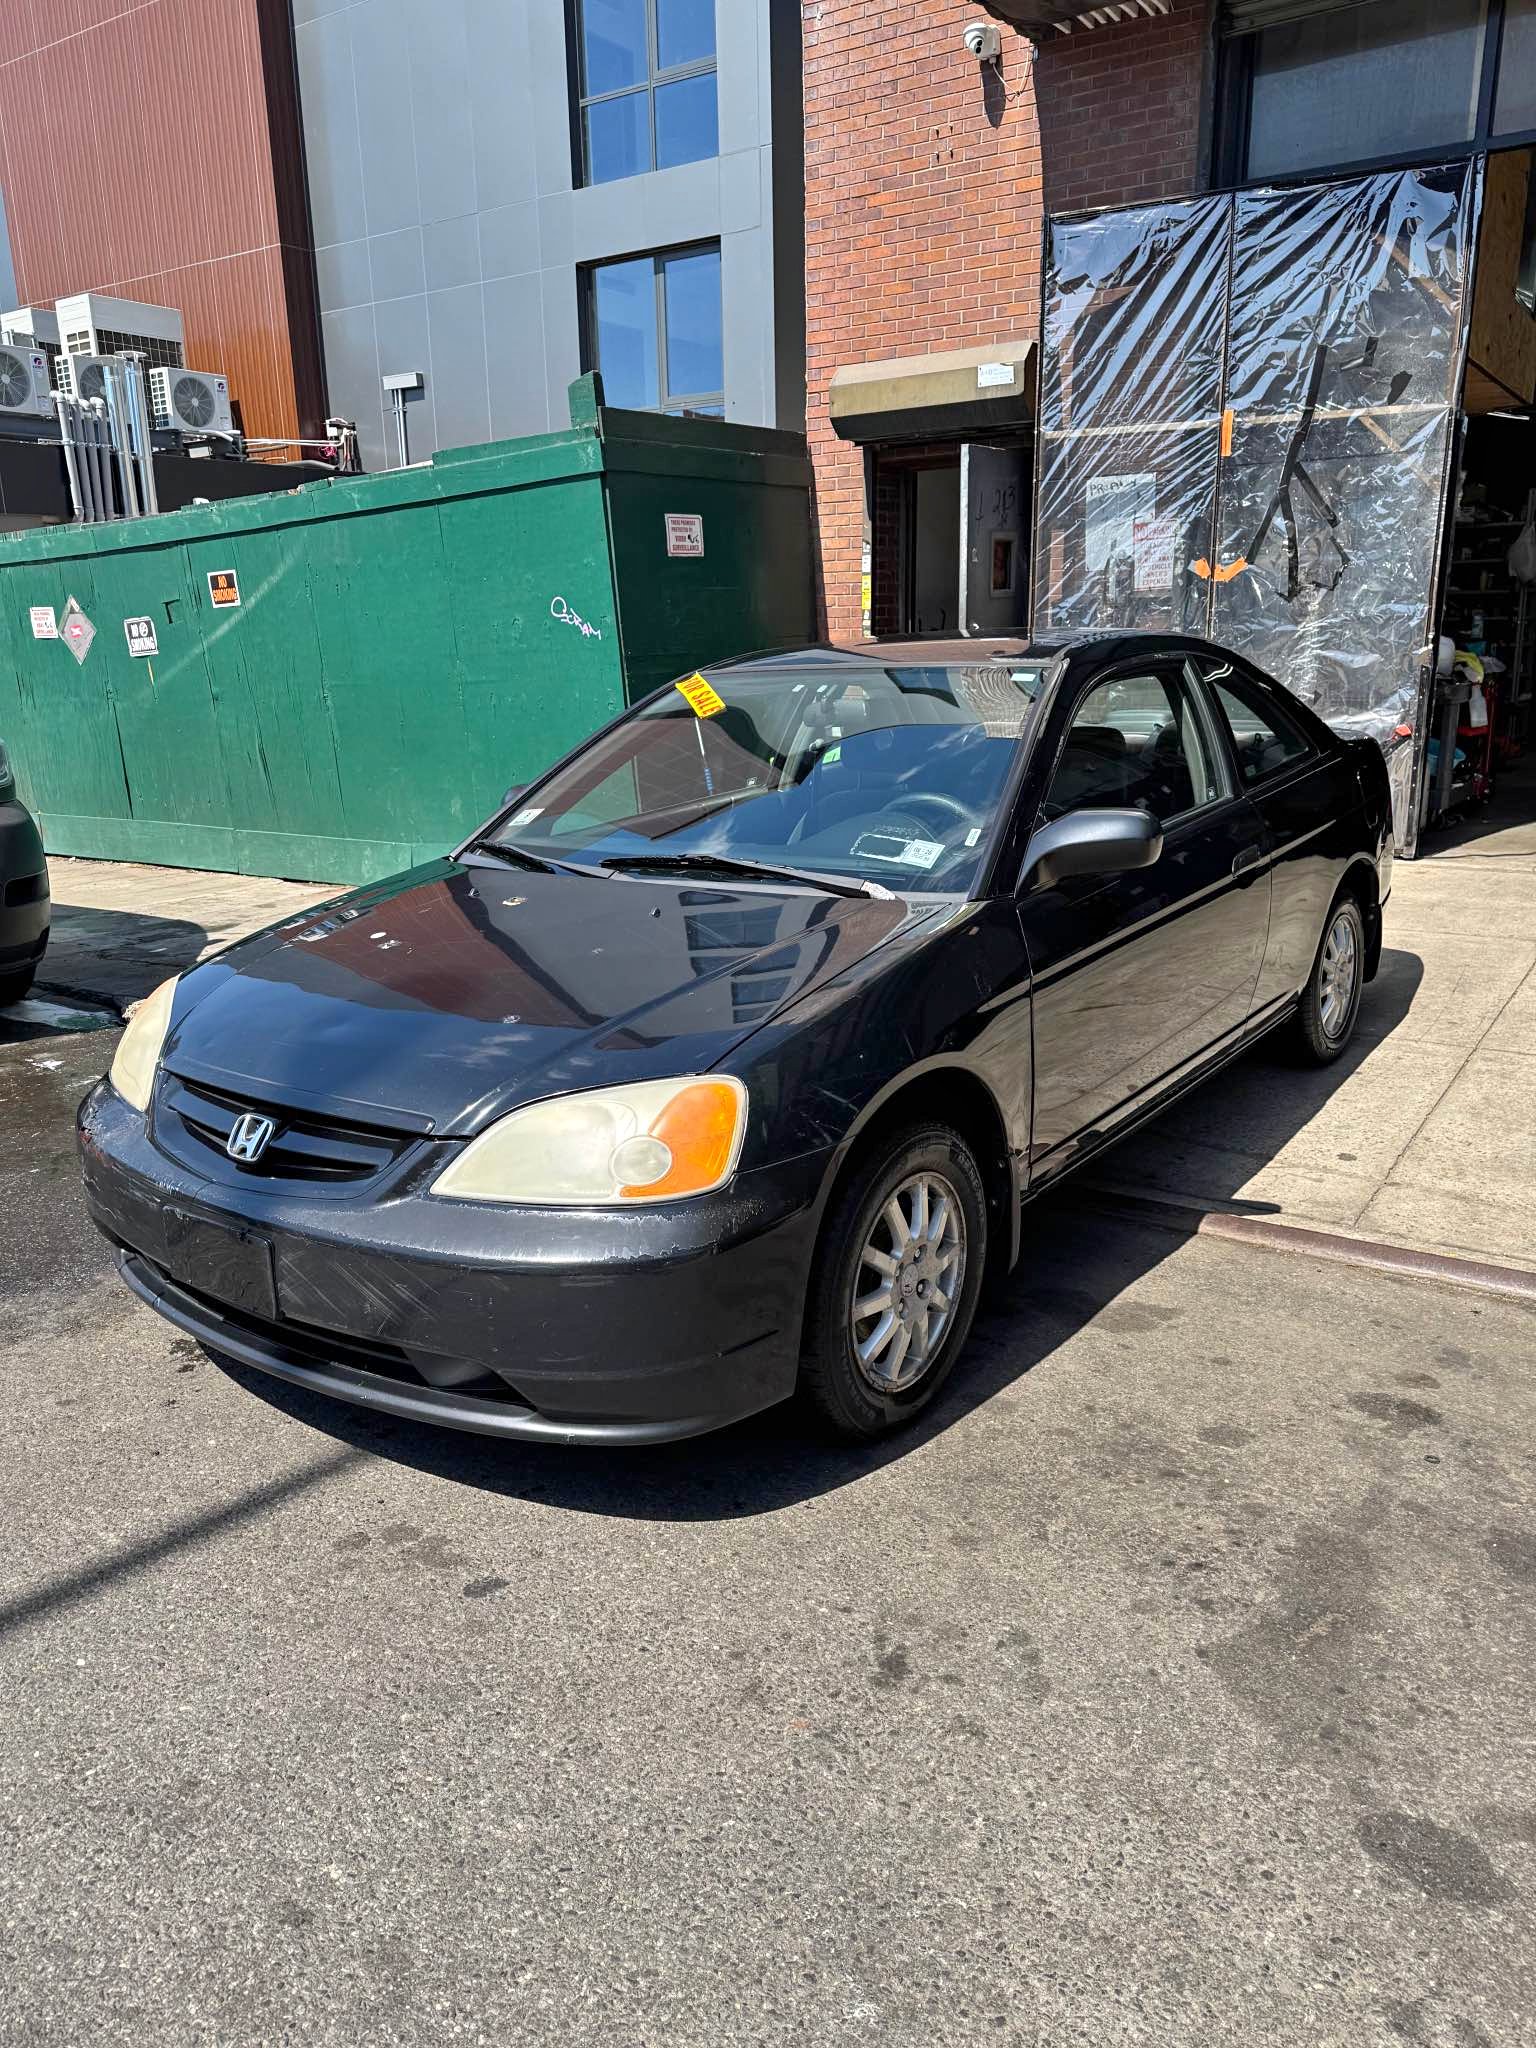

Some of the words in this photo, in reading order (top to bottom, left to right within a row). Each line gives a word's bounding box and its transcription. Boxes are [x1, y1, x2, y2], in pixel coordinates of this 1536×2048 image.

[217, 575, 228, 588] NO
[212, 587, 238, 602] SMOKING
[131, 636, 156, 652] SMOKING
[681, 677, 705, 694] FOR
[691, 690, 721, 715] SALE
